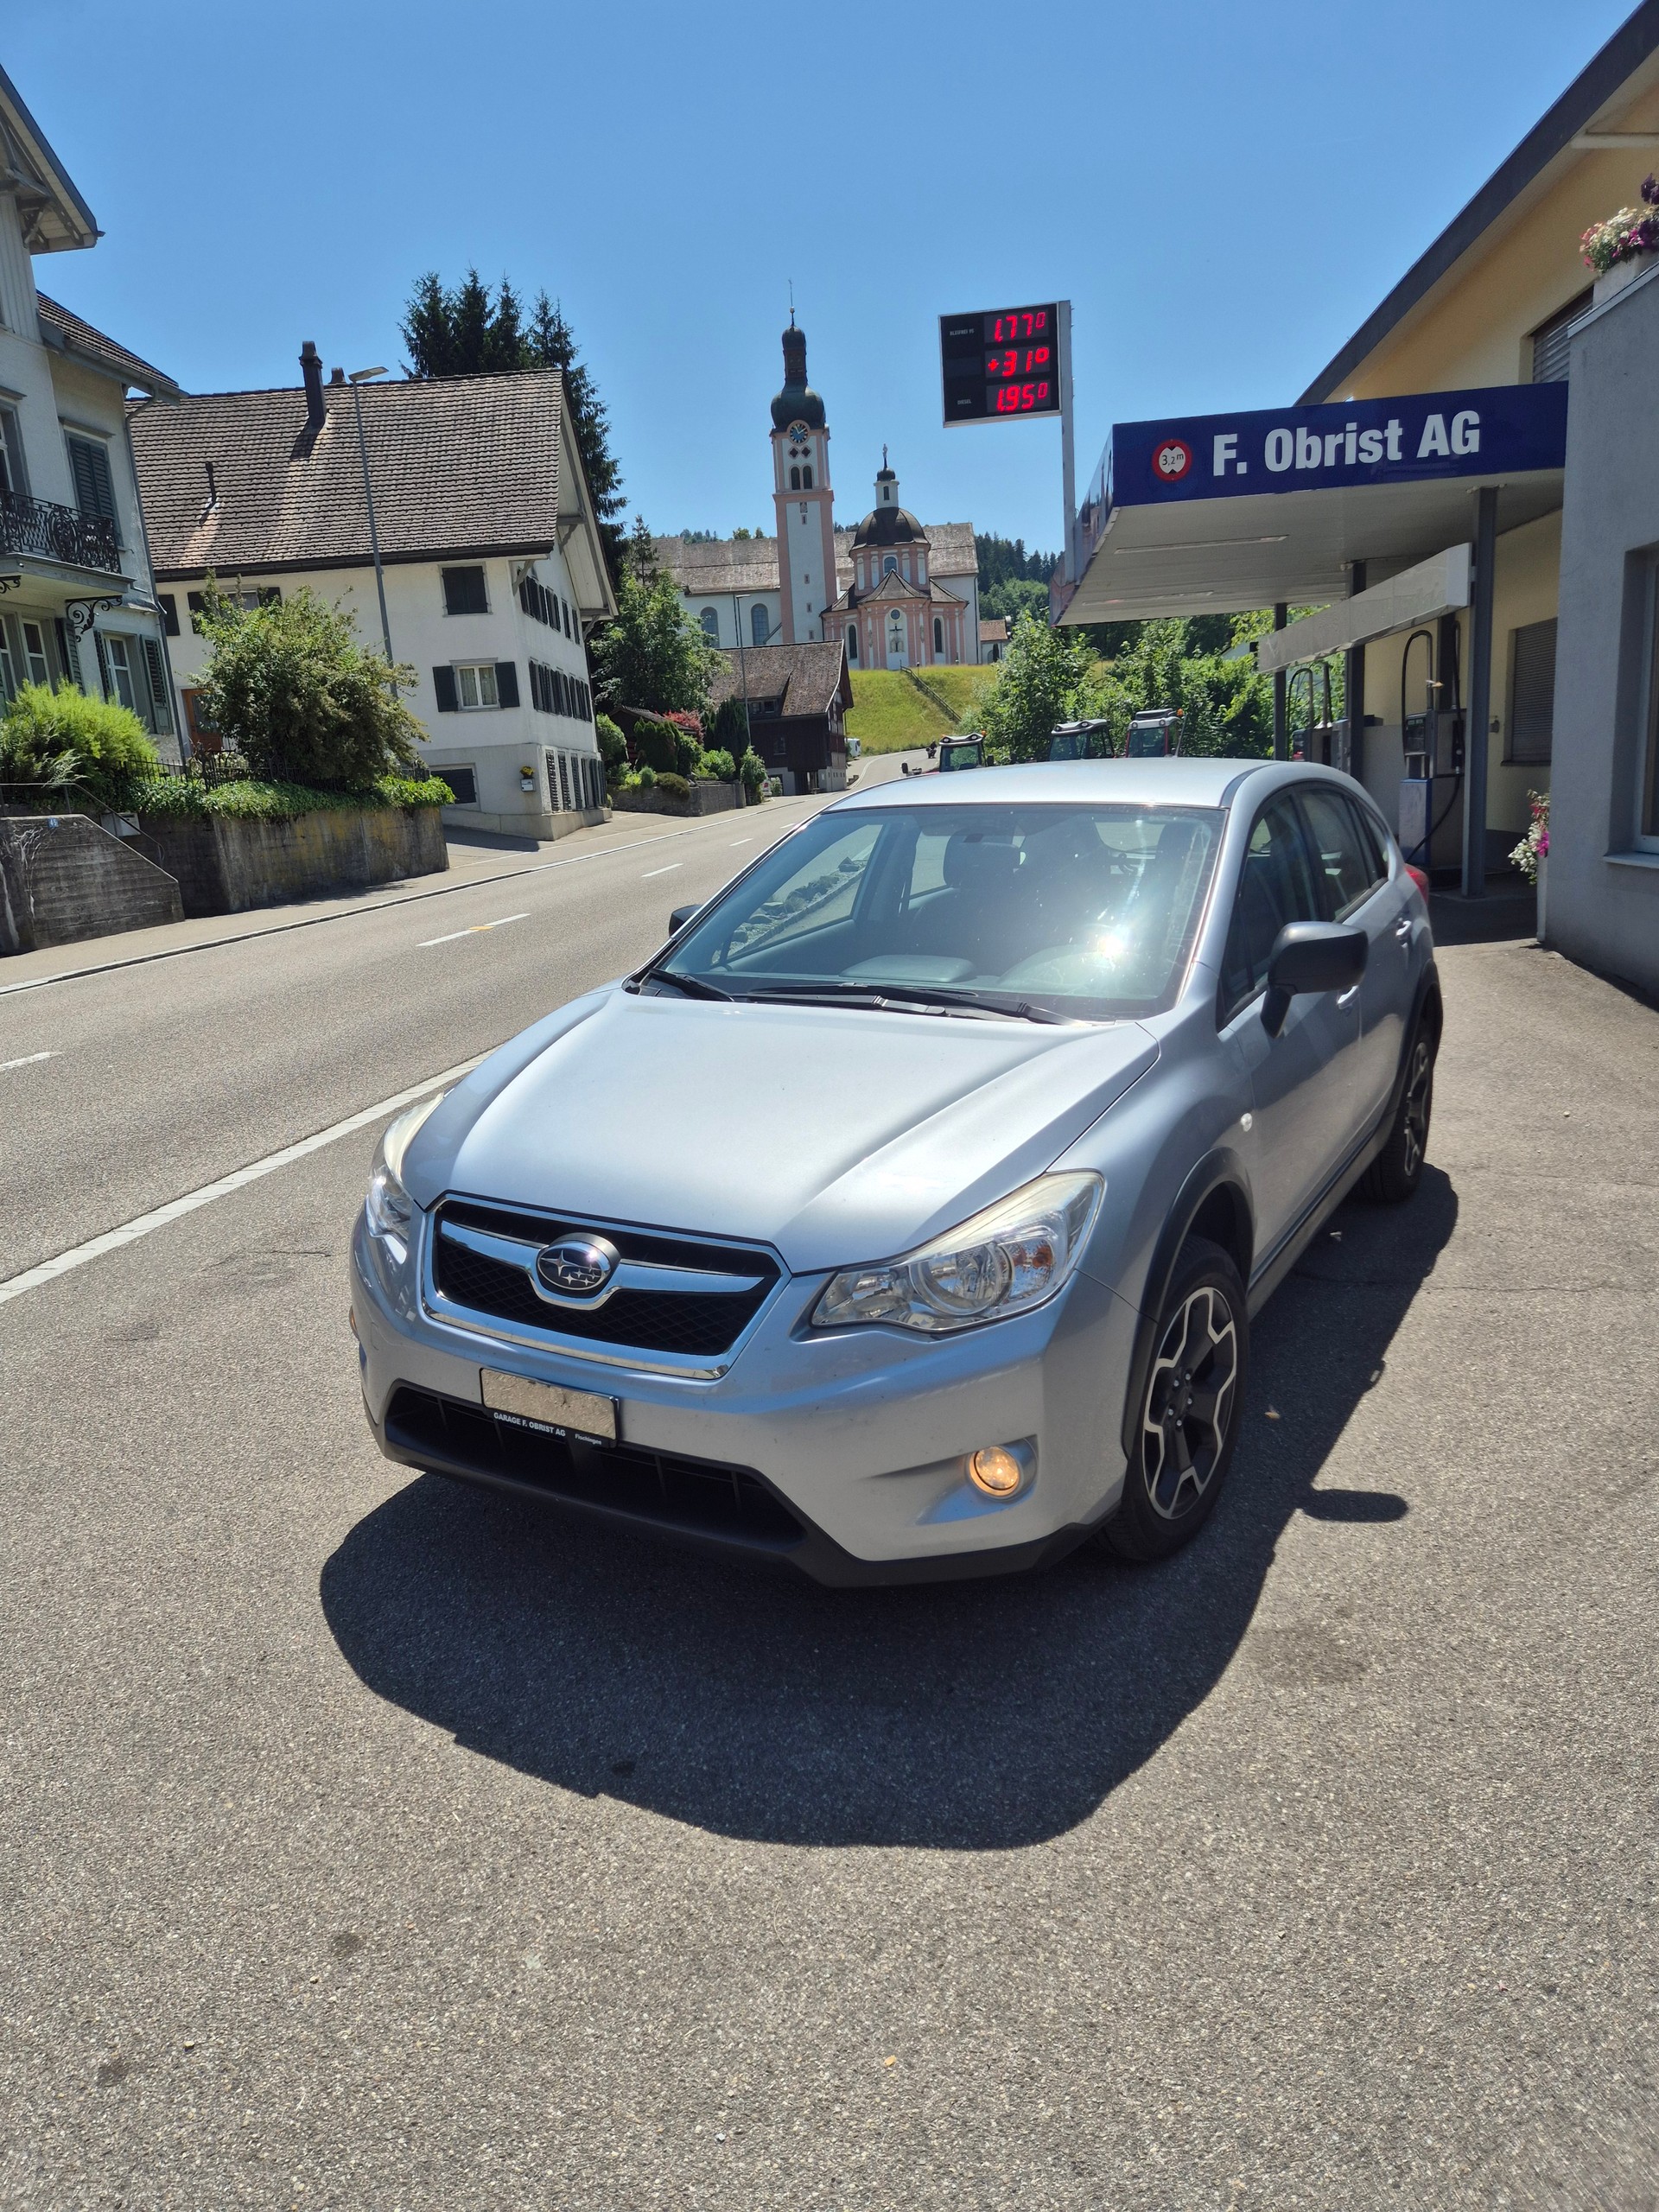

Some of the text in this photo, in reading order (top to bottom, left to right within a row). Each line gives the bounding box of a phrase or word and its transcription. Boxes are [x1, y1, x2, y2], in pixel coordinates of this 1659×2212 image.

[1213, 410, 1480, 476] F. Obrist AG
[493, 1412, 521, 1426] GARAGE
[529, 1421, 554, 1434] OBRIST
[555, 1428, 566, 1437] AG
[575, 1433, 602, 1445] Fischingen
